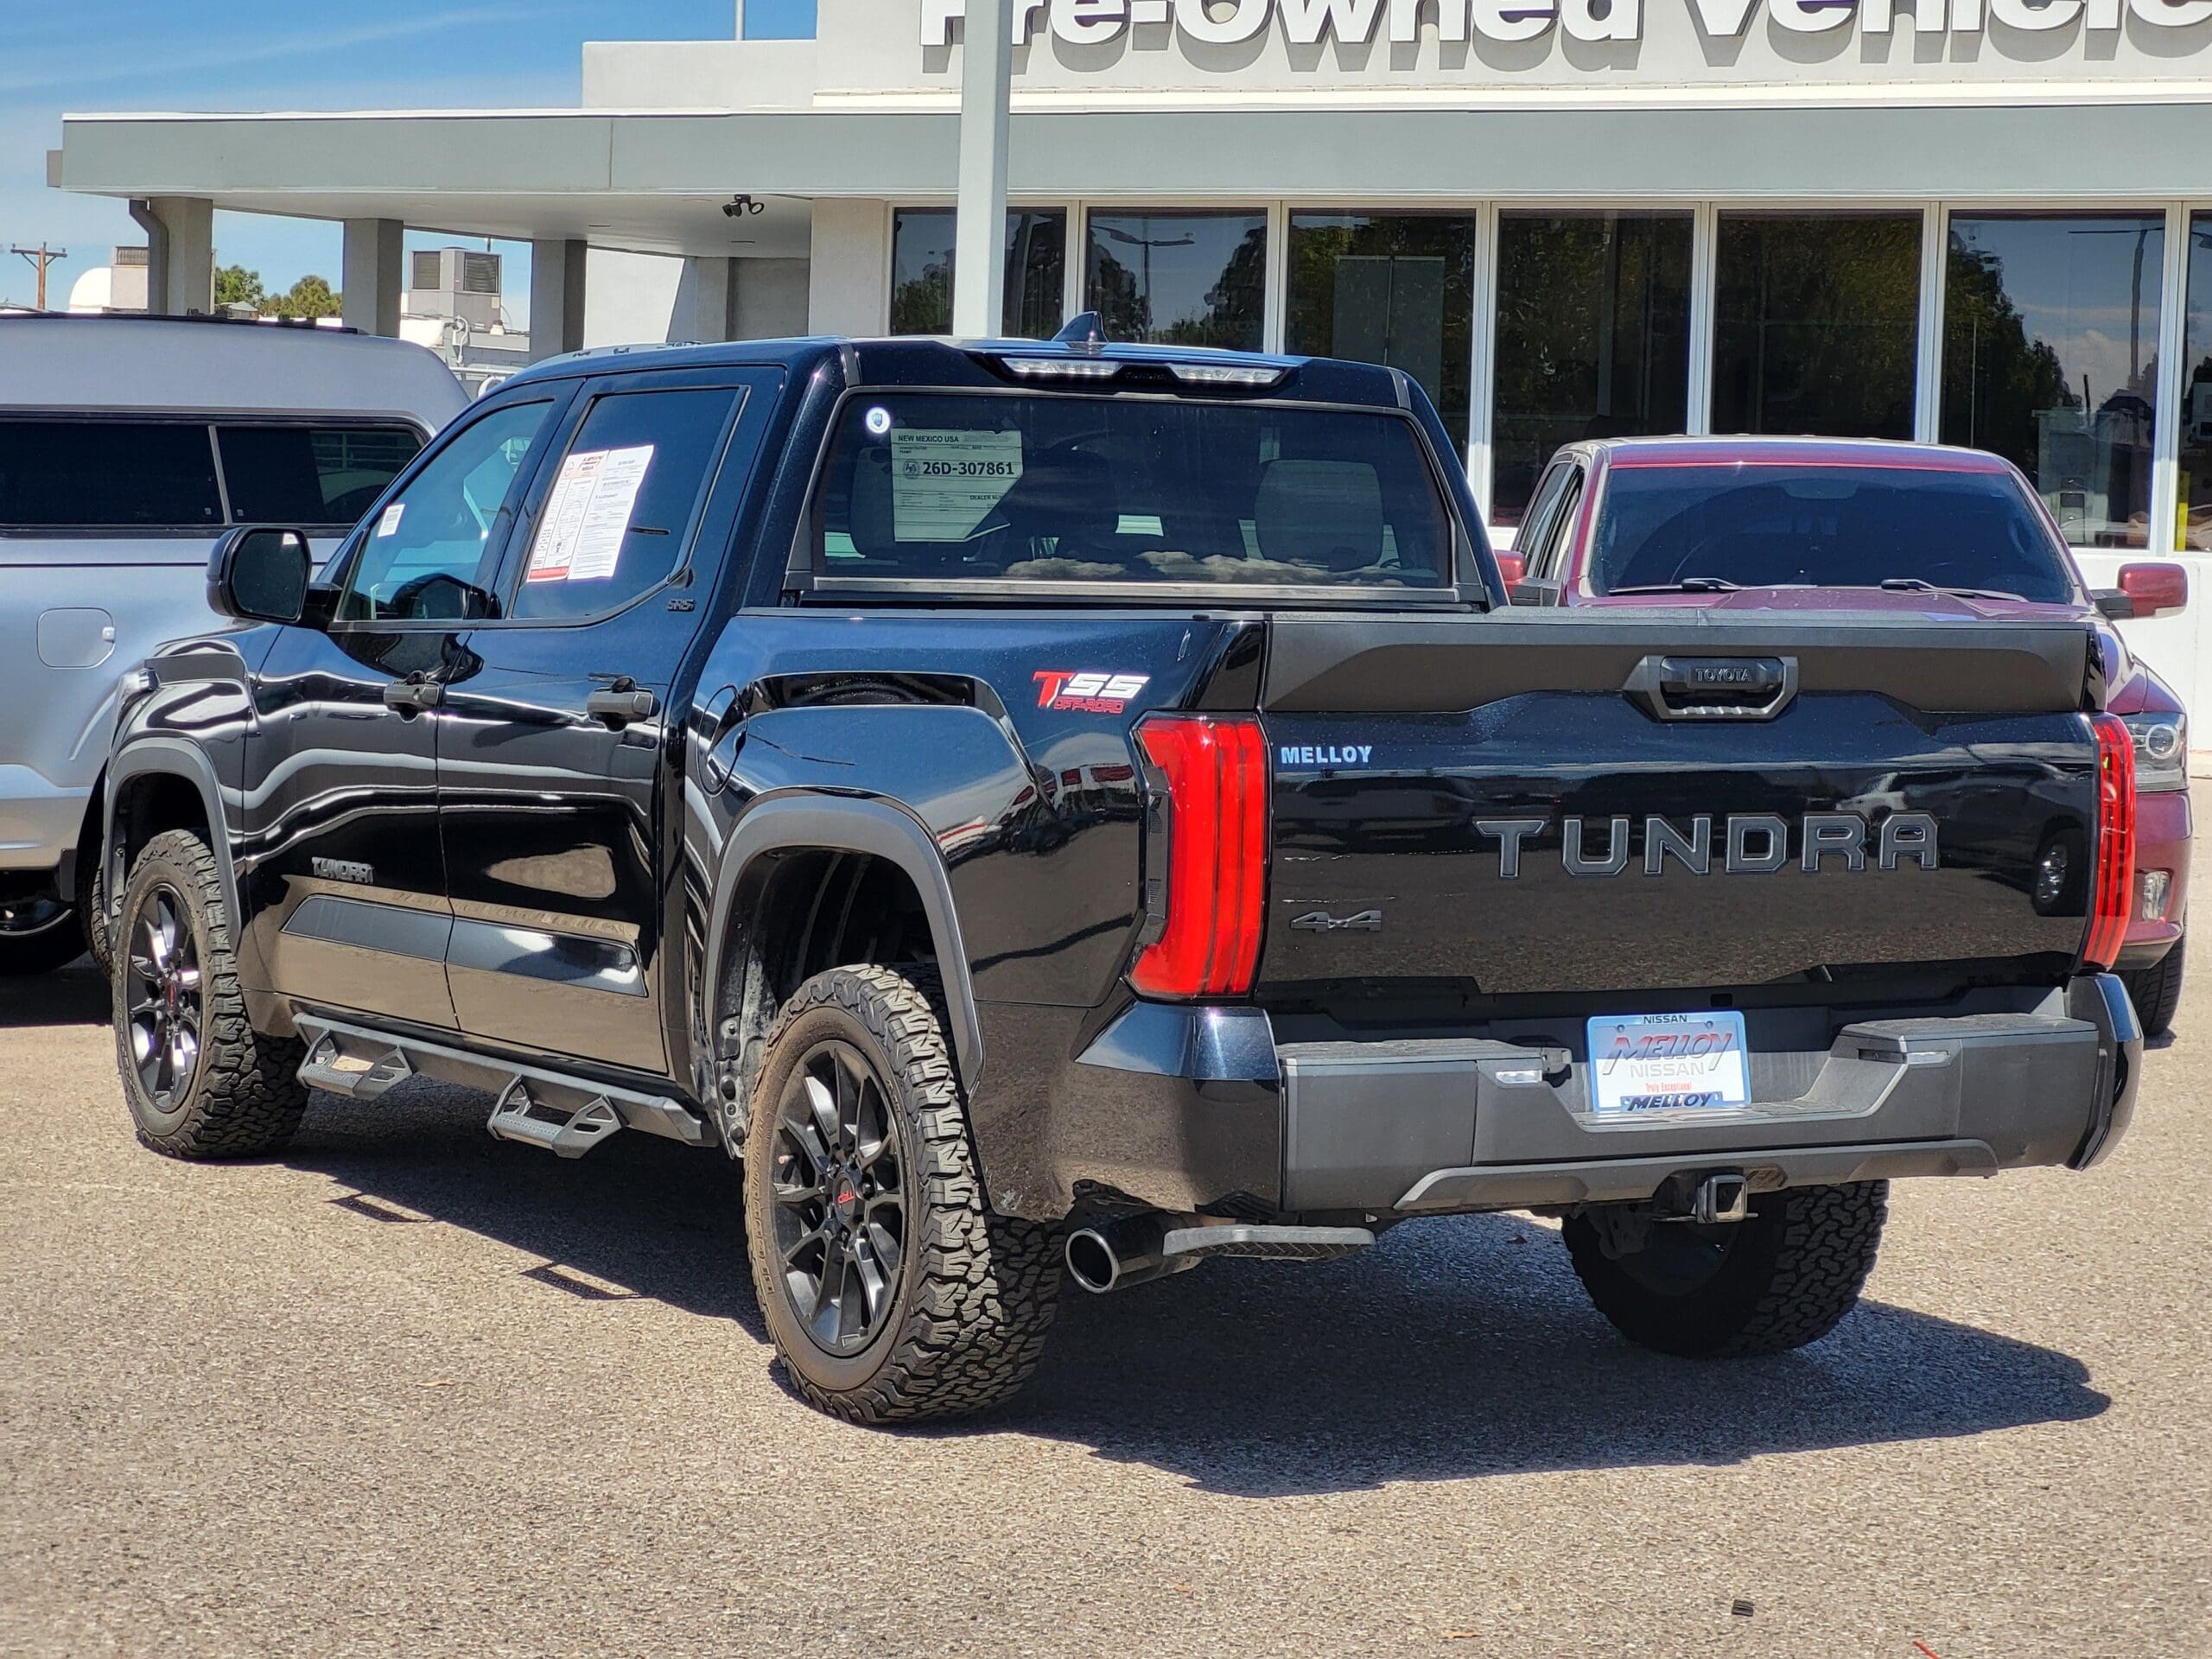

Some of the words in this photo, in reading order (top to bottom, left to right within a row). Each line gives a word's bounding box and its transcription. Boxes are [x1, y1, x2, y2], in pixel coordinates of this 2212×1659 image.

[923, 461, 1014, 475] 26D-307861
[1695, 668, 1752, 682] TOYOTA
[1053, 696, 1124, 714] OFF-ROAD
[1281, 746, 1372, 765] MELLOY
[1472, 810, 1941, 879] TUNDRA
[1643, 1014, 1688, 1024] NISSAN
[1602, 1033, 1732, 1075] MELLOY
[1630, 1062, 1705, 1077] NISSAN
[1627, 1093, 1713, 1111] MELLOY
